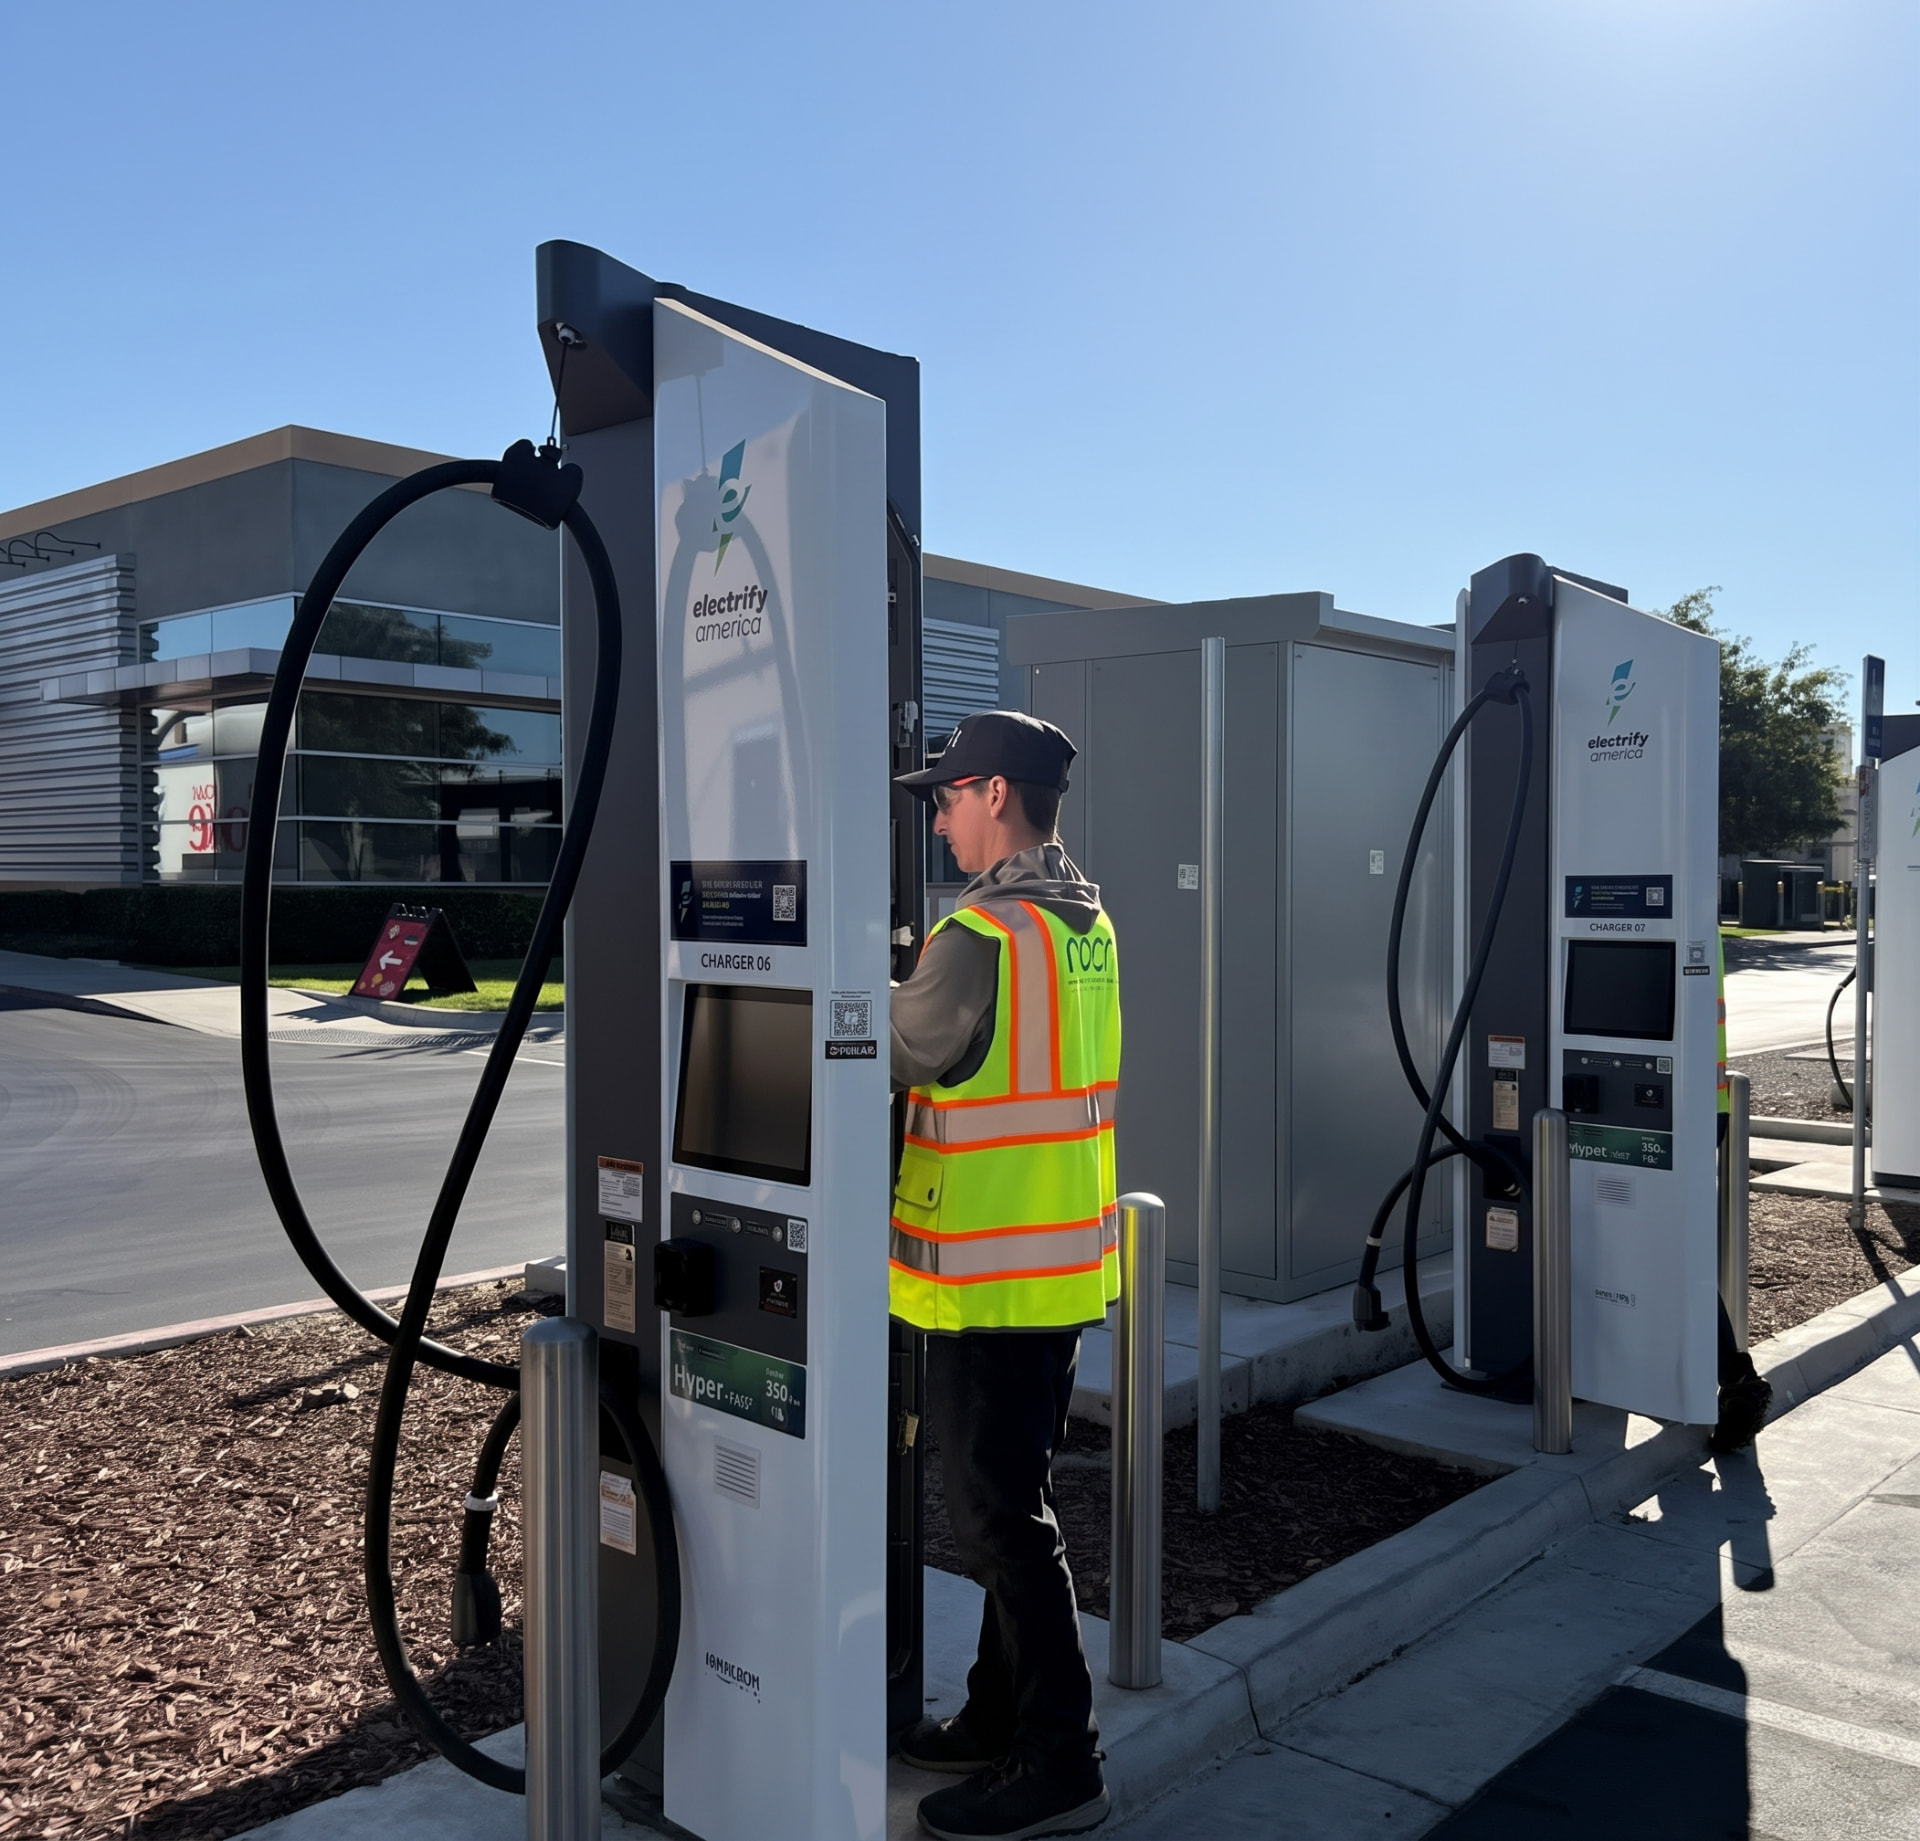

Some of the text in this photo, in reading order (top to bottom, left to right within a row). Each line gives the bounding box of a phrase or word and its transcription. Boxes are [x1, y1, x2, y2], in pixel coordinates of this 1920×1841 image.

[693, 585, 768, 617] electrify
[696, 614, 761, 643] america
[1588, 732, 1649, 749] electrify
[1590, 748, 1643, 762] america
[1589, 923, 1646, 932] CHARGER 07
[701, 953, 771, 971] CHARGER 06
[1641, 1142, 1660, 1153] 350
[674, 1363, 724, 1400] Hyper
[766, 1380, 788, 1402] 350
